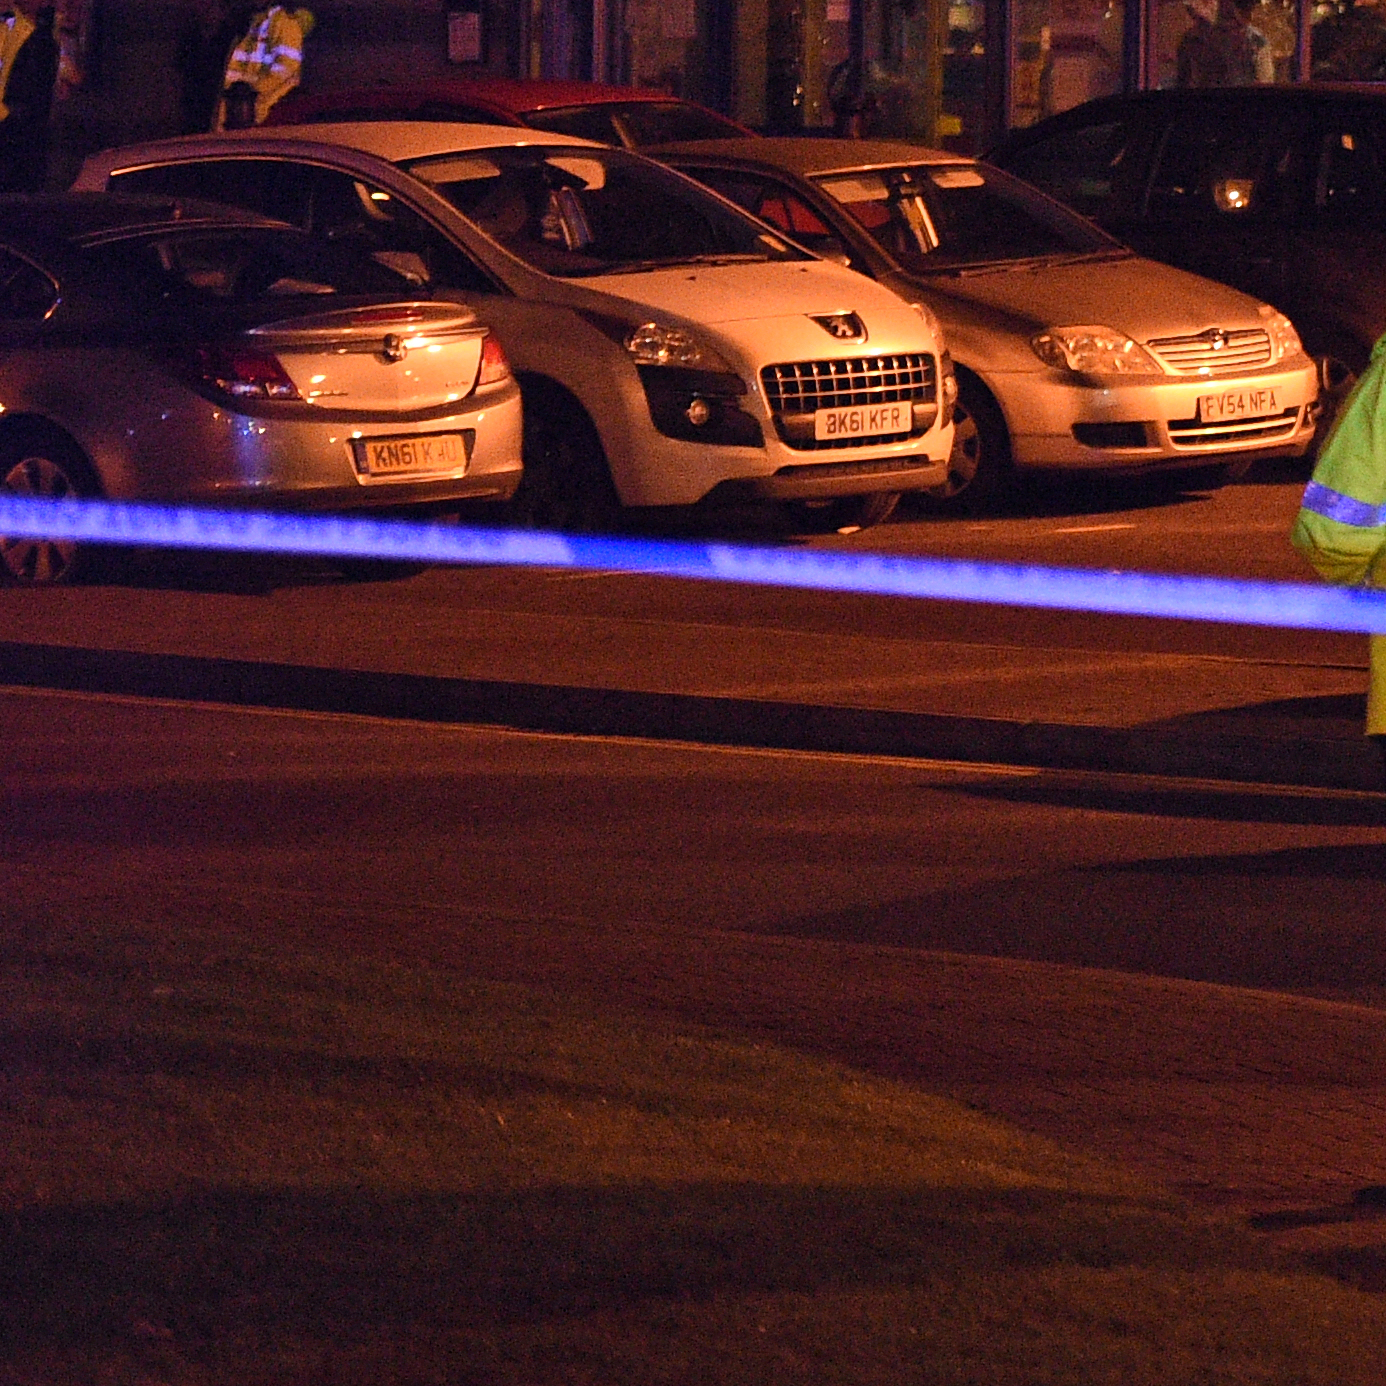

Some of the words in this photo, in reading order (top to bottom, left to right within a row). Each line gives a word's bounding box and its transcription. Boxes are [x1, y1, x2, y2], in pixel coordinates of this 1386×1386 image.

[1206, 394, 1246, 417] FV54
[1249, 390, 1278, 412] NFA
[869, 407, 900, 430] KFR
[373, 441, 419, 468] KN61
